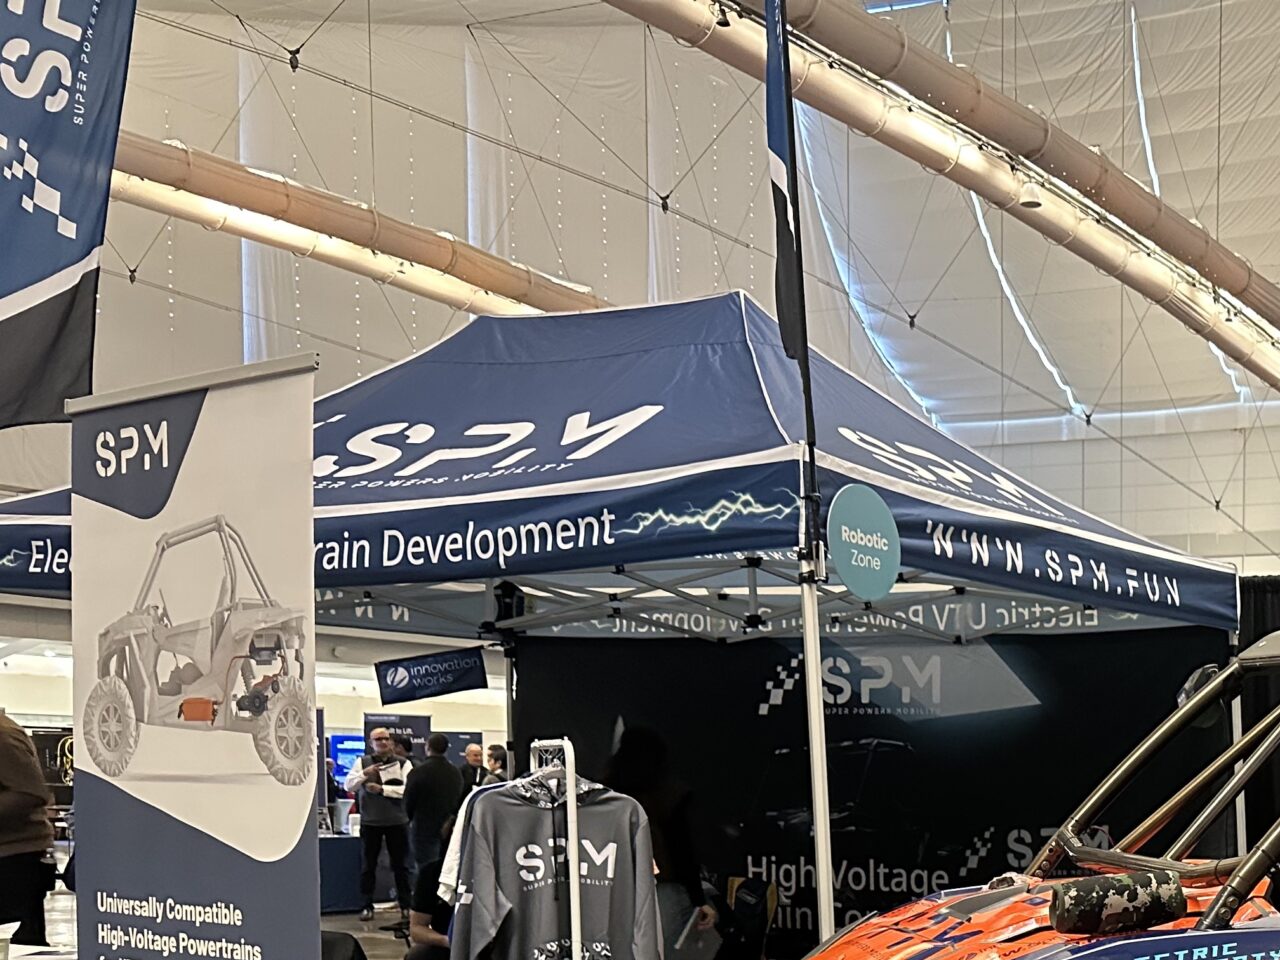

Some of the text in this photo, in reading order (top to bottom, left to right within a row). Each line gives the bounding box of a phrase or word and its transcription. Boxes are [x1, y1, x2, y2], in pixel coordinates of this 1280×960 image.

[73, 70, 88, 125] SUPER
[95, 420, 170, 478] SPM
[838, 427, 1065, 517] SPM
[382, 508, 617, 570] Development
[841, 524, 889, 552] Robotic
[850, 551, 882, 571] Zone
[410, 655, 480, 677] innovation
[413, 672, 454, 688] works
[822, 655, 941, 704] SPM
[825, 707, 849, 715] UPER
[1007, 825, 1109, 867] SM
[747, 855, 817, 897] High
[97, 891, 243, 926] Universally Compatible
[97, 923, 177, 956] High-Voltage
